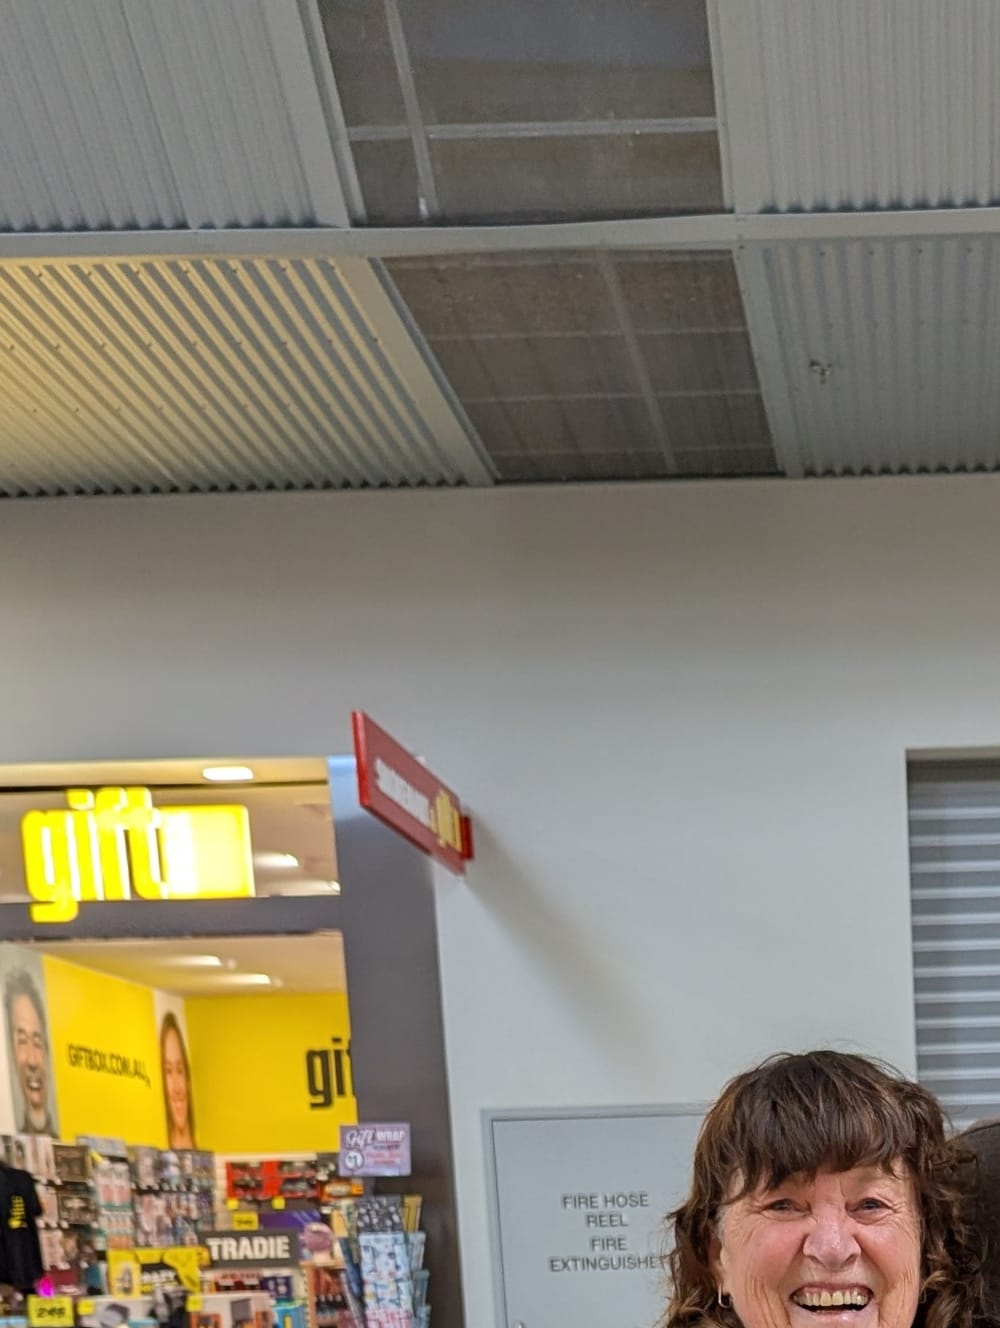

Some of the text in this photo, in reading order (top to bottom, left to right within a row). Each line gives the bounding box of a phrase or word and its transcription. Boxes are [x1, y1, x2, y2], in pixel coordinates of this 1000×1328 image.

[305, 1036, 354, 1110] gi
[561, 1193, 649, 1209] FIRE HOSE
[586, 1213, 629, 1228] REEL
[206, 1235, 290, 1261] TRADIE
[590, 1237, 628, 1251] FIRE
